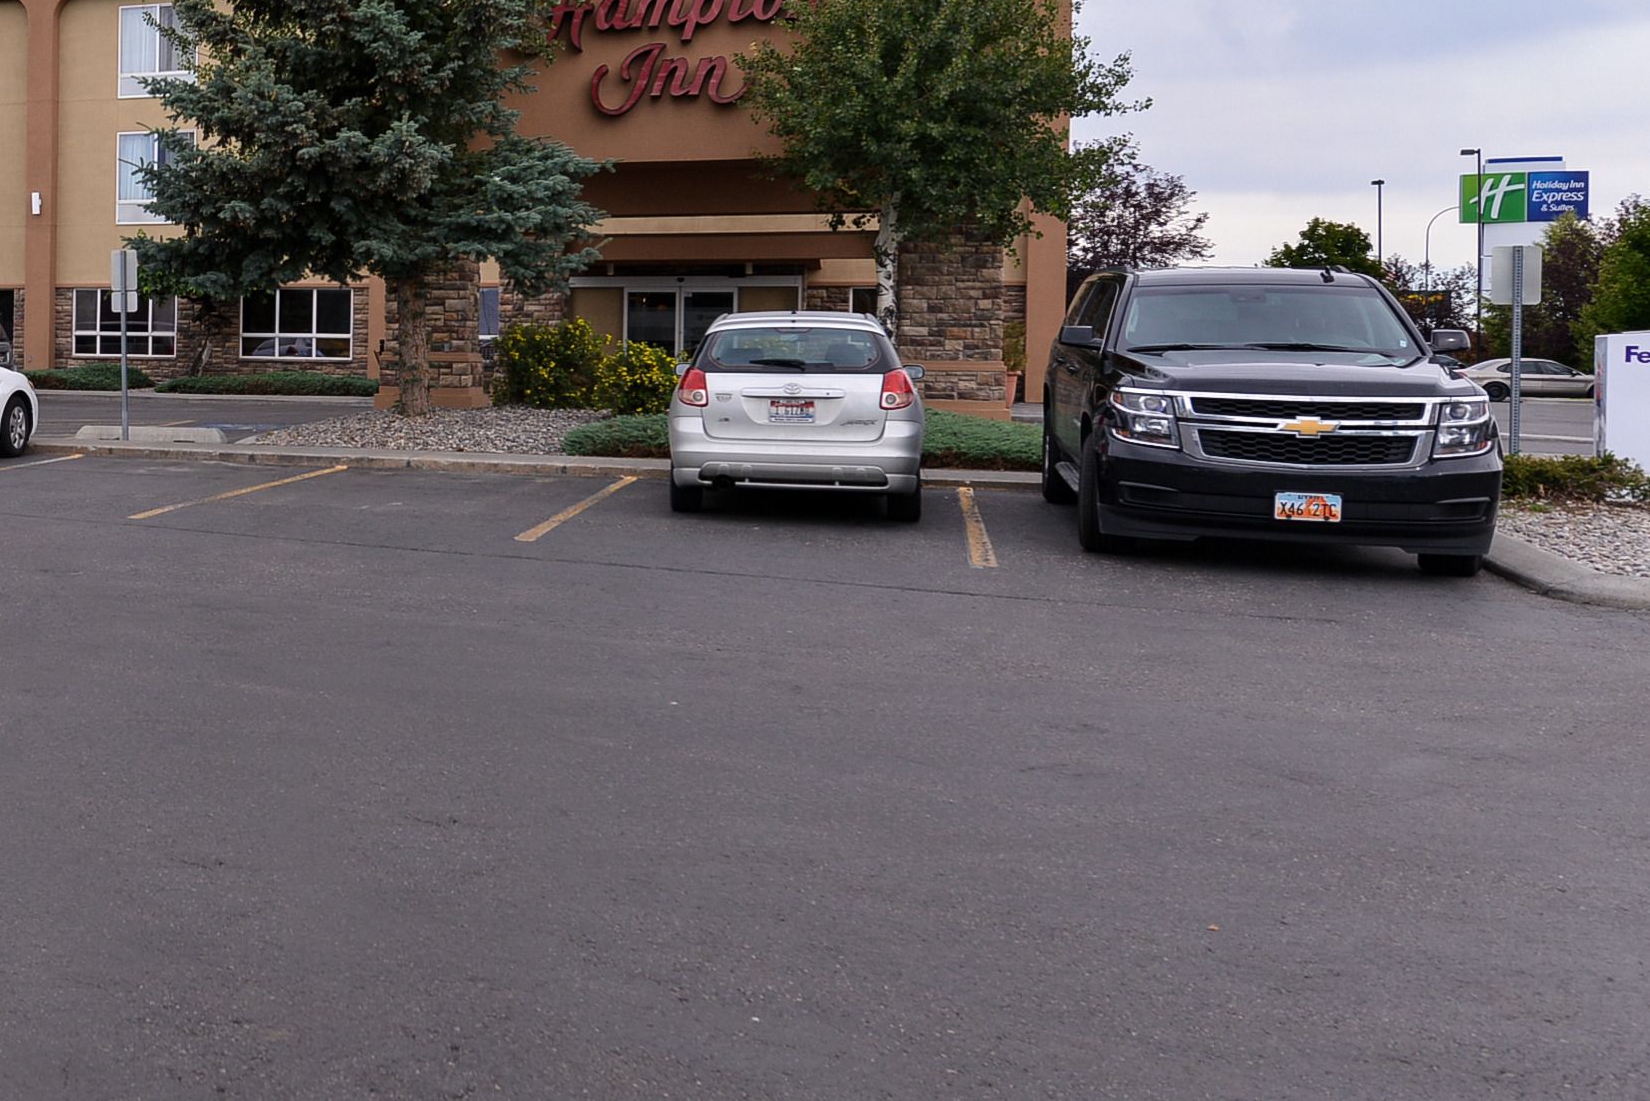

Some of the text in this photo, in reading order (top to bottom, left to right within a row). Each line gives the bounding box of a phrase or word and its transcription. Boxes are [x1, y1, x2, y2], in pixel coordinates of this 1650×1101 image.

[591, 42, 752, 116] Inn
[1533, 180, 1585, 190] Holiday Inn
[1532, 190, 1584, 203] Express
[1279, 501, 1304, 516] X46
